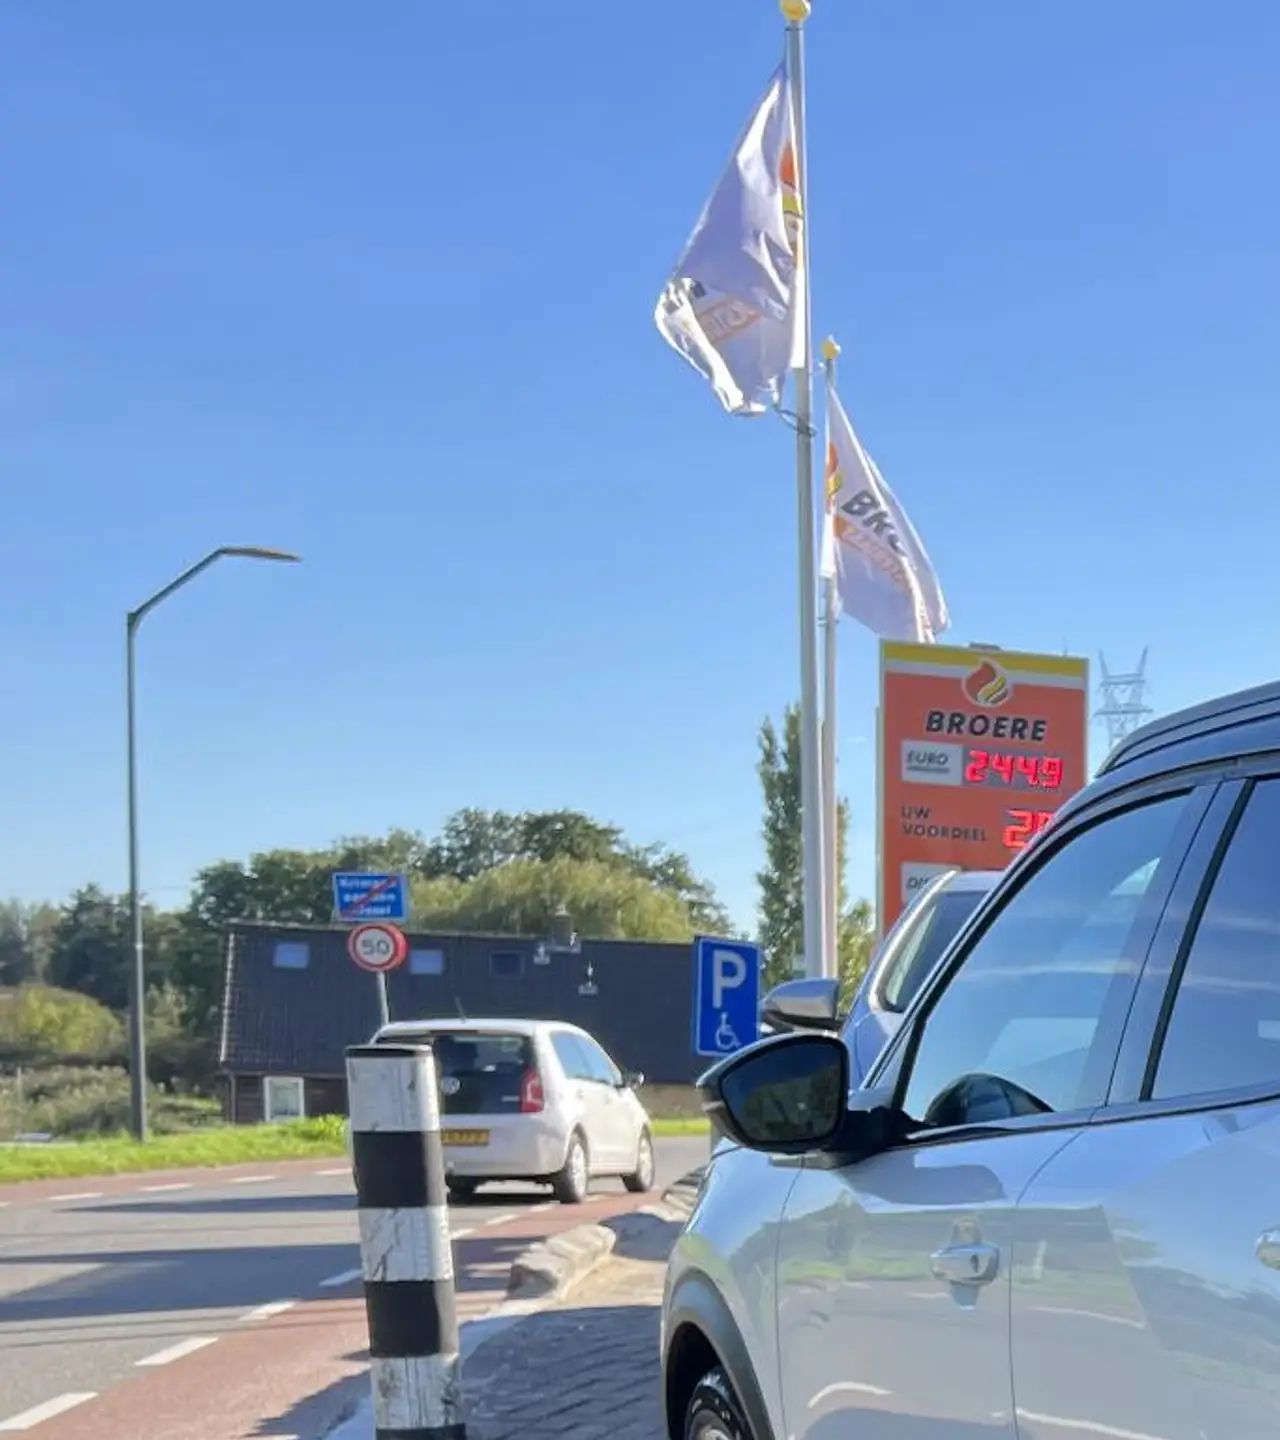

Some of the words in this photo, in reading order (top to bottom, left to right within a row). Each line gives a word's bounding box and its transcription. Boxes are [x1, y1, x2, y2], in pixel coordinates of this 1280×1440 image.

[926, 710, 1047, 741] BROERE
[906, 750, 949, 765] EURO
[901, 804, 931, 819] UW
[361, 940, 390, 956] 50
[712, 950, 746, 1008] P
